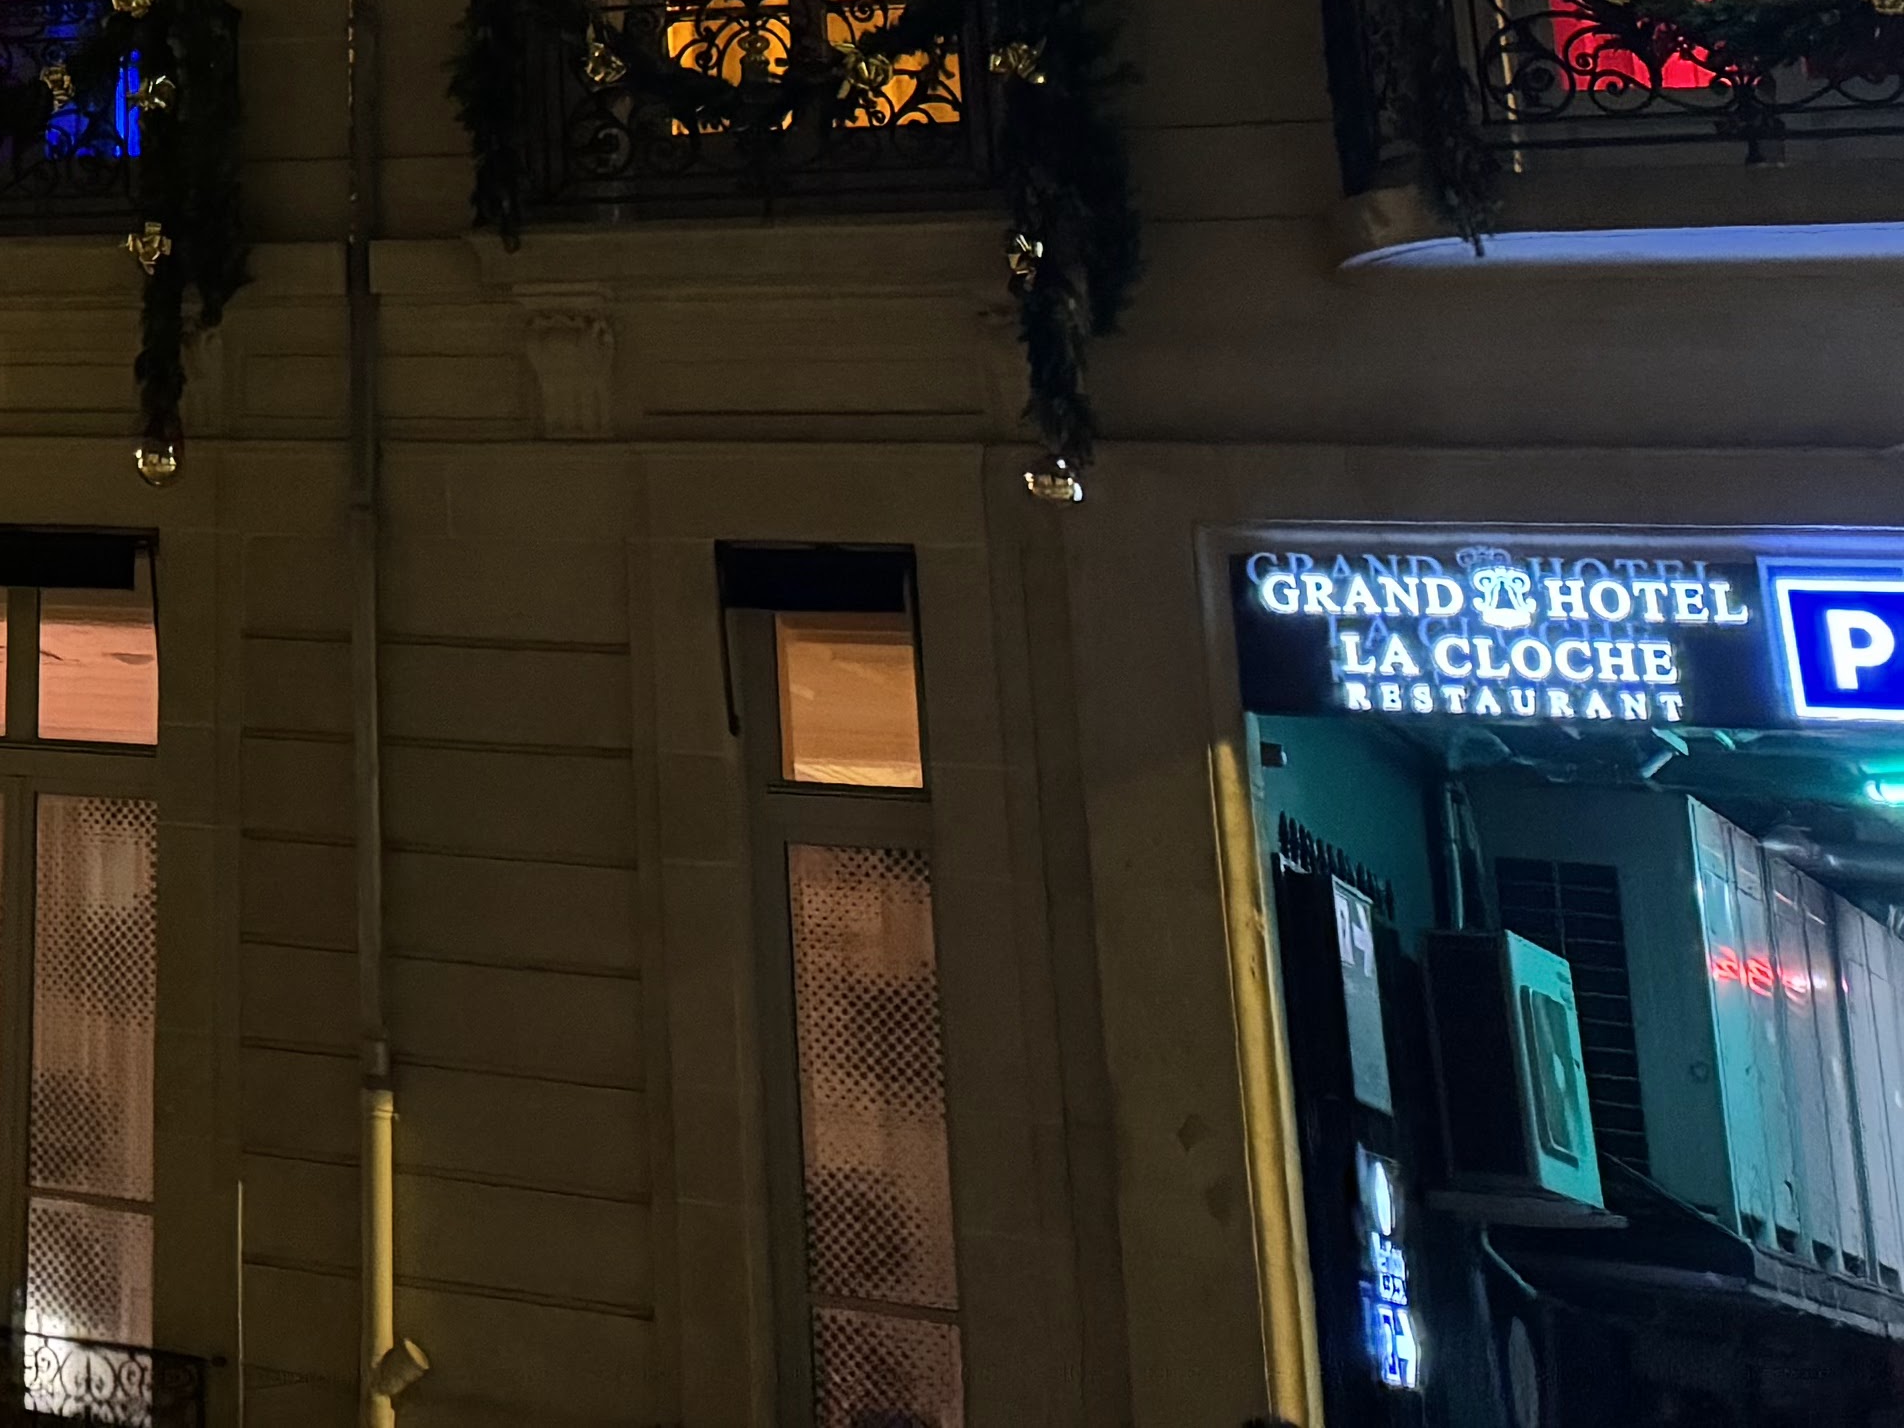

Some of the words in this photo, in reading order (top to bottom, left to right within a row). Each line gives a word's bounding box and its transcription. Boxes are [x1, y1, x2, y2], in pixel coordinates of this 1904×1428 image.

[1260, 571, 1465, 617] GRAND
[1543, 577, 1749, 625] HOTEL
[1340, 630, 1420, 678] LA
[1433, 633, 1679, 684] CLOCHE
[1826, 608, 1895, 690] P
[1345, 681, 1684, 722] RESTAURANT
